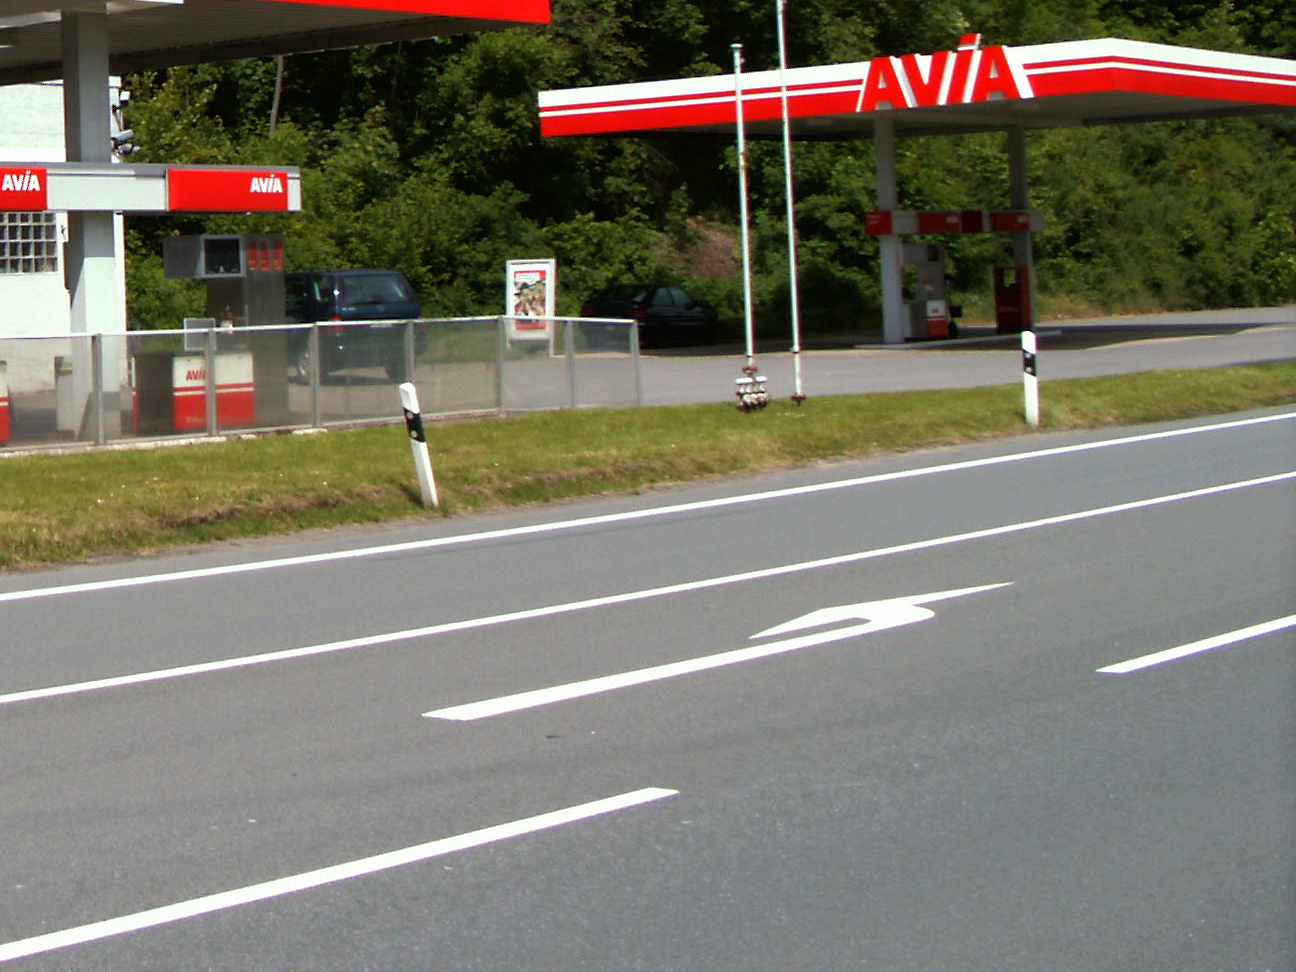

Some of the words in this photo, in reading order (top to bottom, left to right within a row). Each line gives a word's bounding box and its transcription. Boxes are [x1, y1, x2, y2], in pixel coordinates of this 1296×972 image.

[857, 33, 1034, 113] AVIA
[2, 171, 40, 191] AVIA
[250, 174, 283, 193] AVIA
